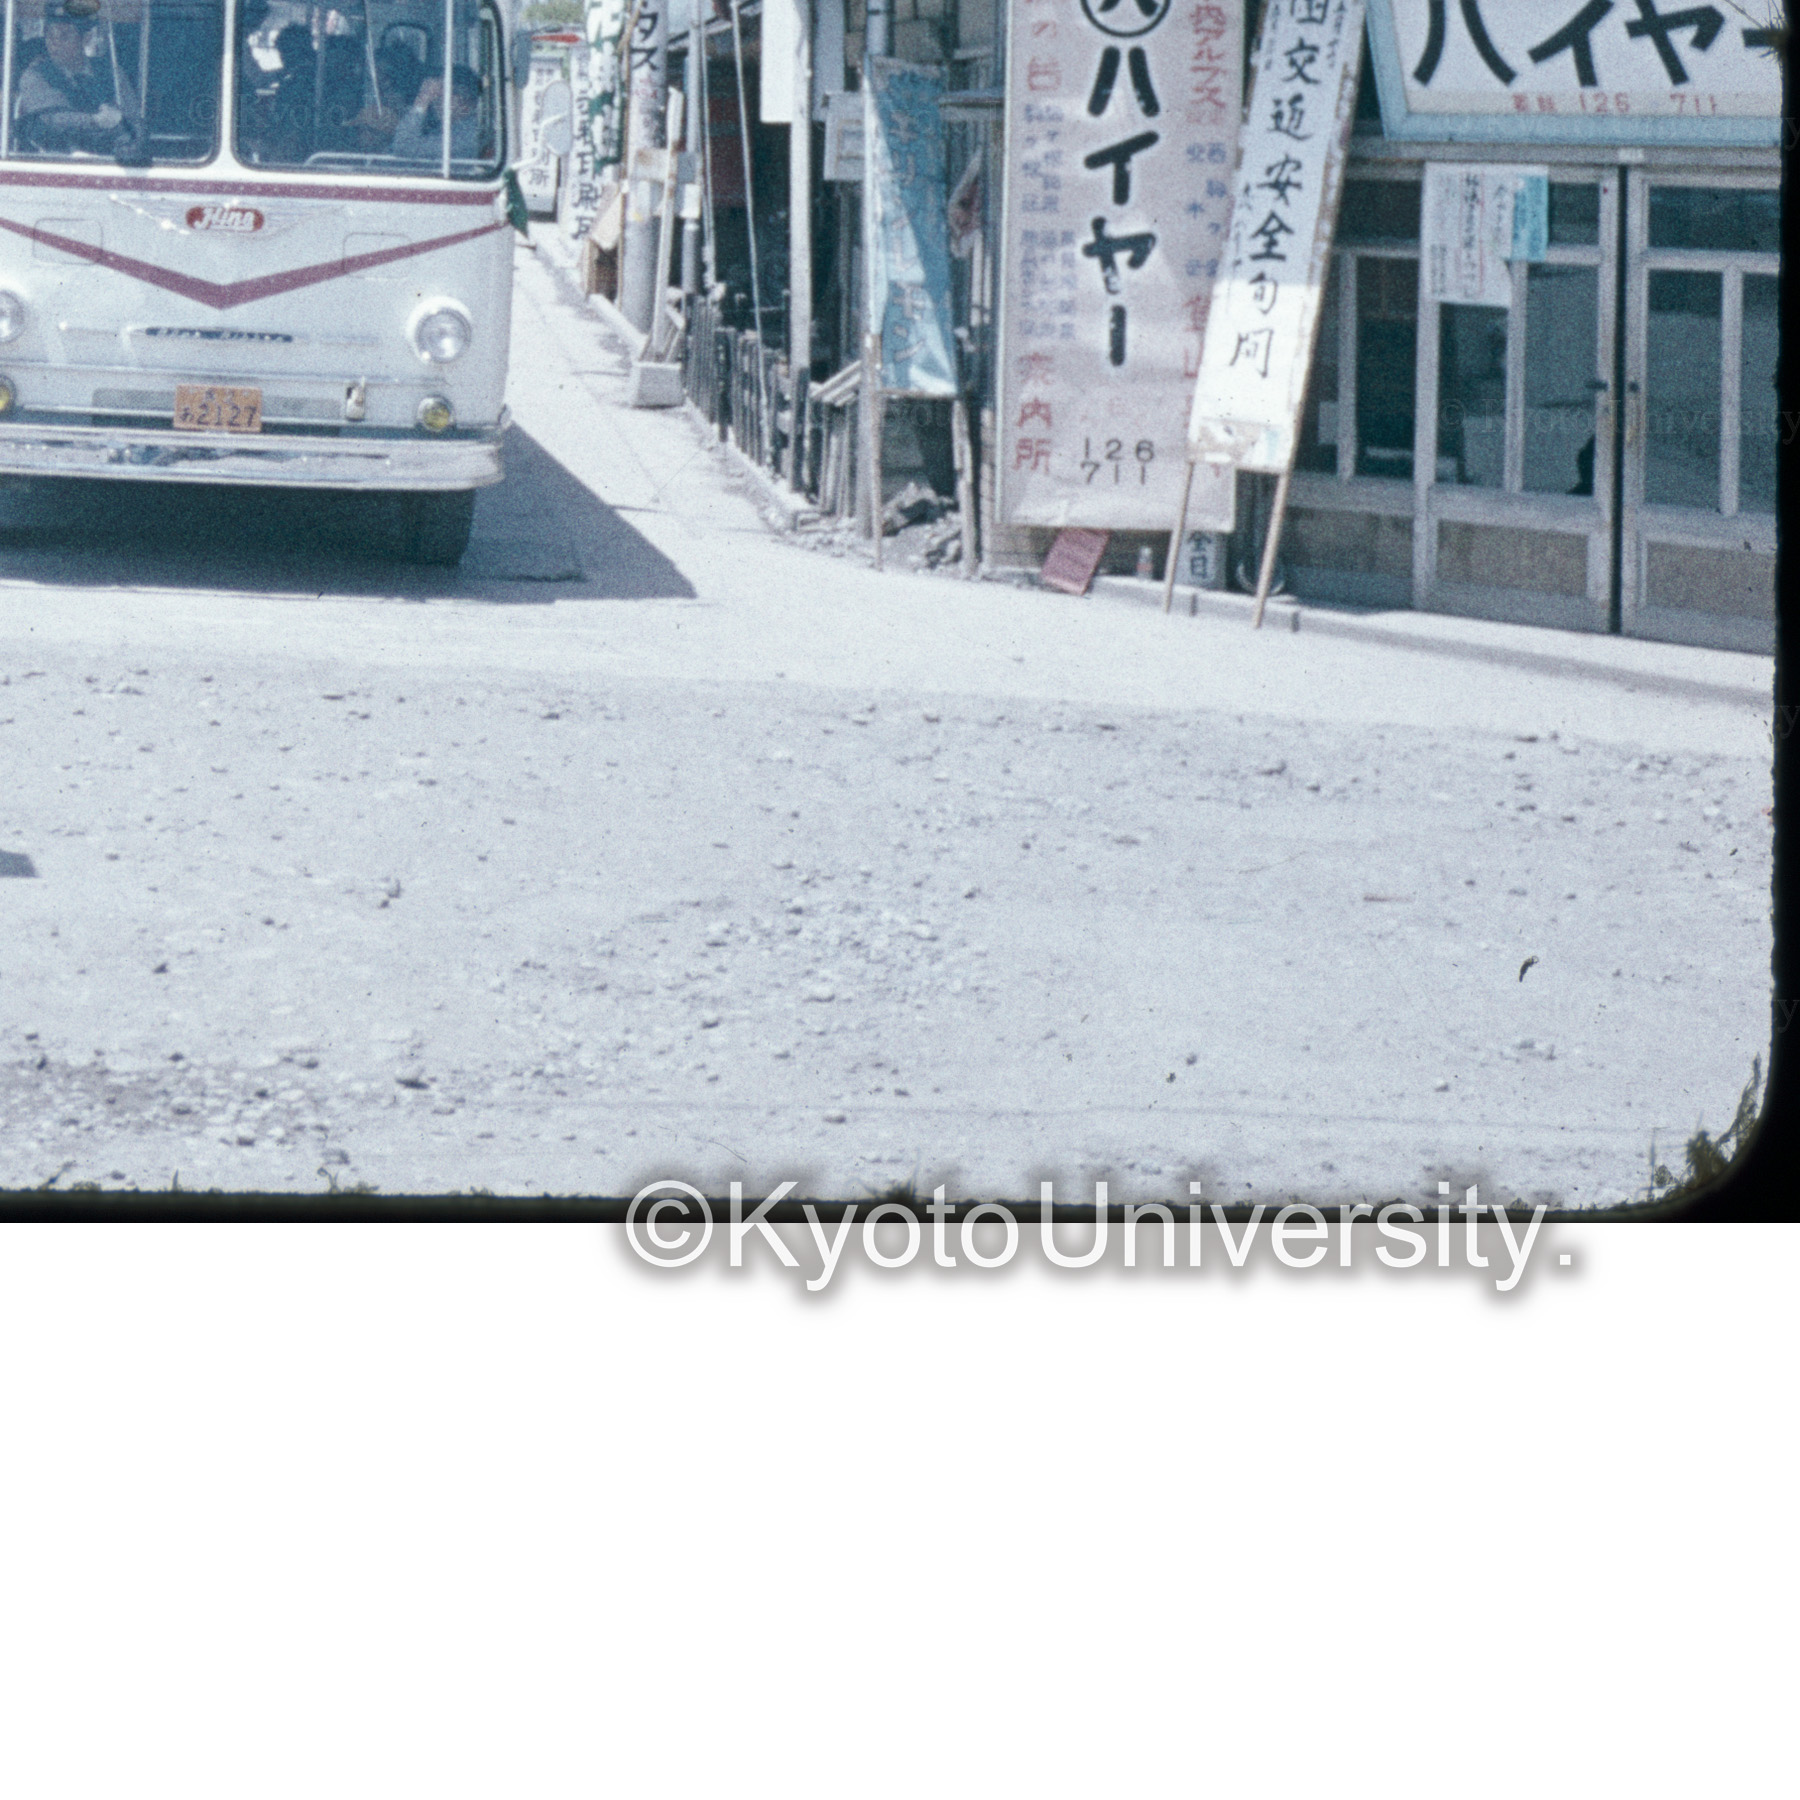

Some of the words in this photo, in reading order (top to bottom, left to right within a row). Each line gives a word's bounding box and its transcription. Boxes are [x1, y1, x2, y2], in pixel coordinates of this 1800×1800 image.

[1084, 46, 1160, 366] ハイヤー
[1084, 437, 1154, 462] 126
[1080, 461, 1146, 485] 711
